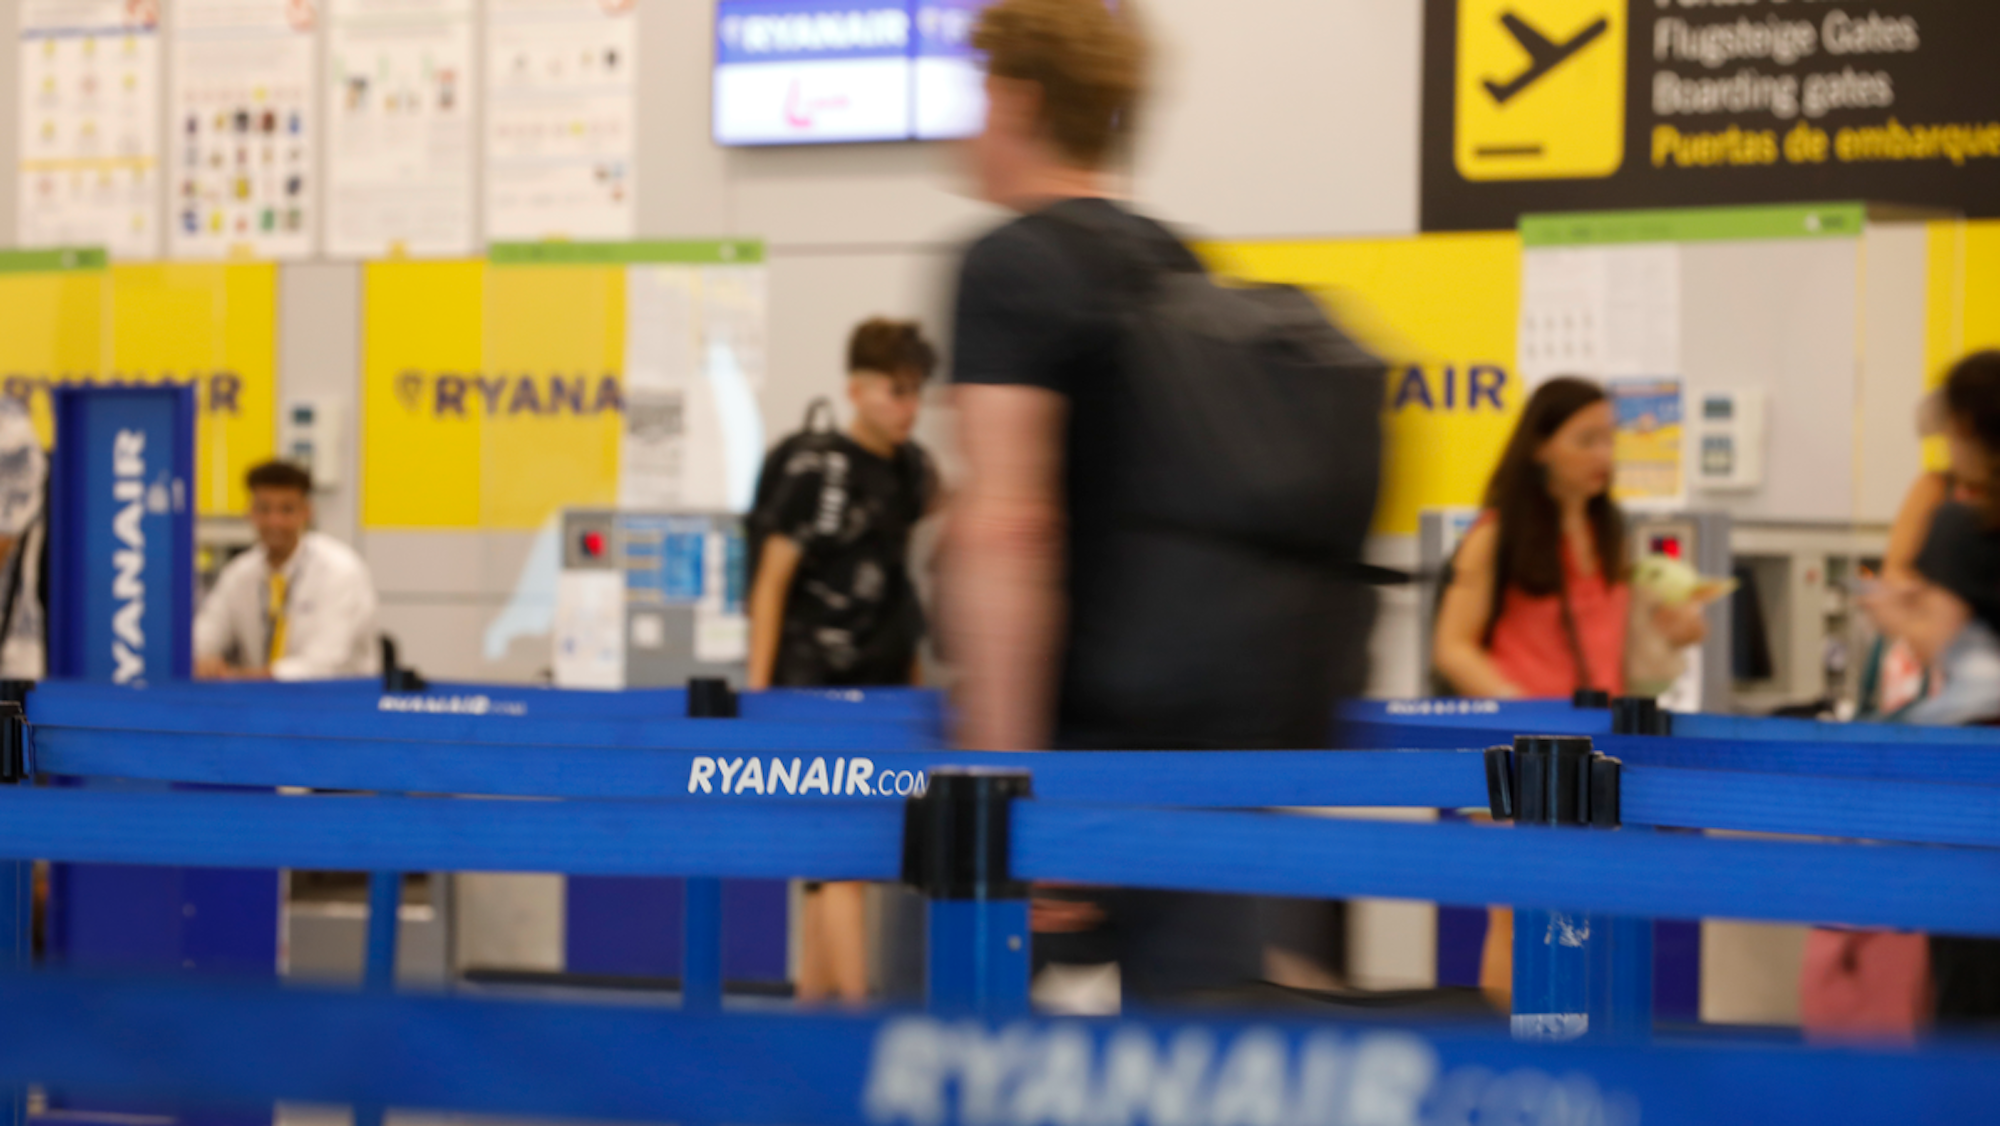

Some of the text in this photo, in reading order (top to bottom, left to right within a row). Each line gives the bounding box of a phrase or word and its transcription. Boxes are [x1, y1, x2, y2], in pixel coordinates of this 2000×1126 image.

[1654, 9, 1919, 68] Flugsteige Gates
[1653, 63, 1893, 118] Boarding gates
[1651, 123, 1777, 167] Puertas
[1783, 118, 1829, 162] de
[436, 374, 625, 414] RYANA
[1394, 365, 1506, 410] AIR
[113, 428, 147, 688] YANAIR
